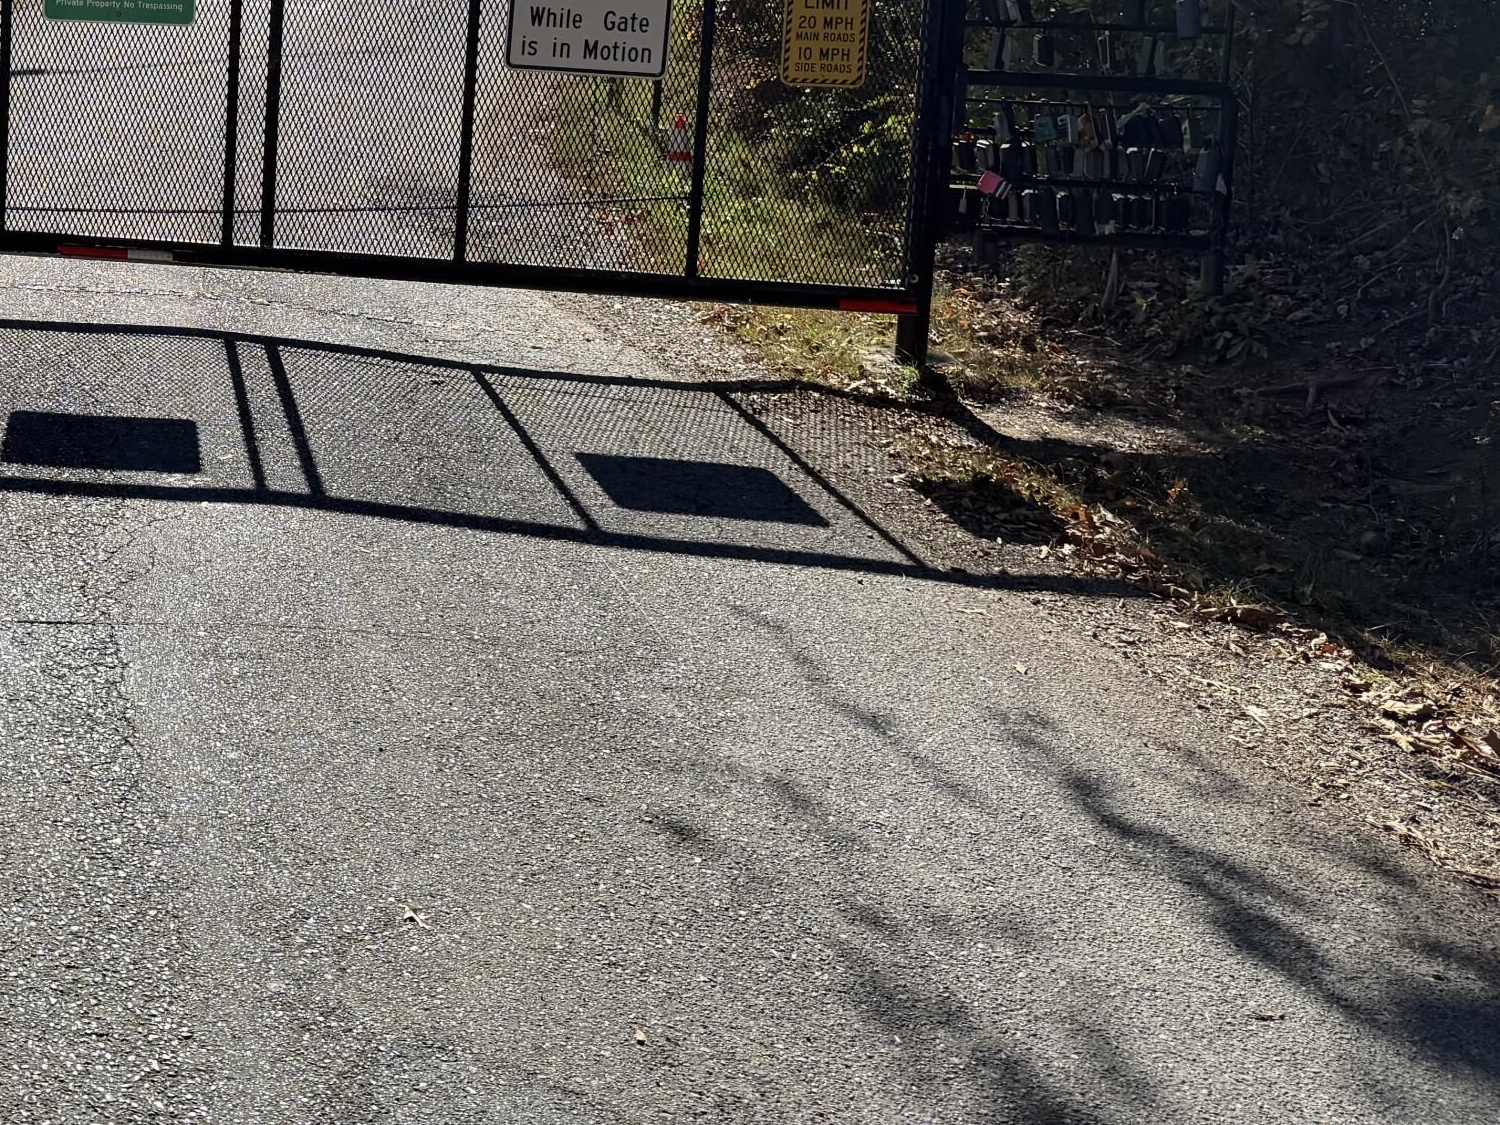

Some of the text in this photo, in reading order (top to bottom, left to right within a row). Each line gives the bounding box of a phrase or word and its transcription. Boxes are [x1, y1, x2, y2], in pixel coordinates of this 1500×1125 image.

[123, 0, 135, 9] No
[138, 0, 183, 12] Trespassing
[530, 5, 650, 34] While Gate
[798, 15, 854, 31] 20 MPH
[795, 31, 855, 43] MAIN ROADS
[521, 35, 652, 64] is in Motion
[798, 46, 850, 62] 10 MPH
[794, 62, 852, 74] SIDE ROADS
